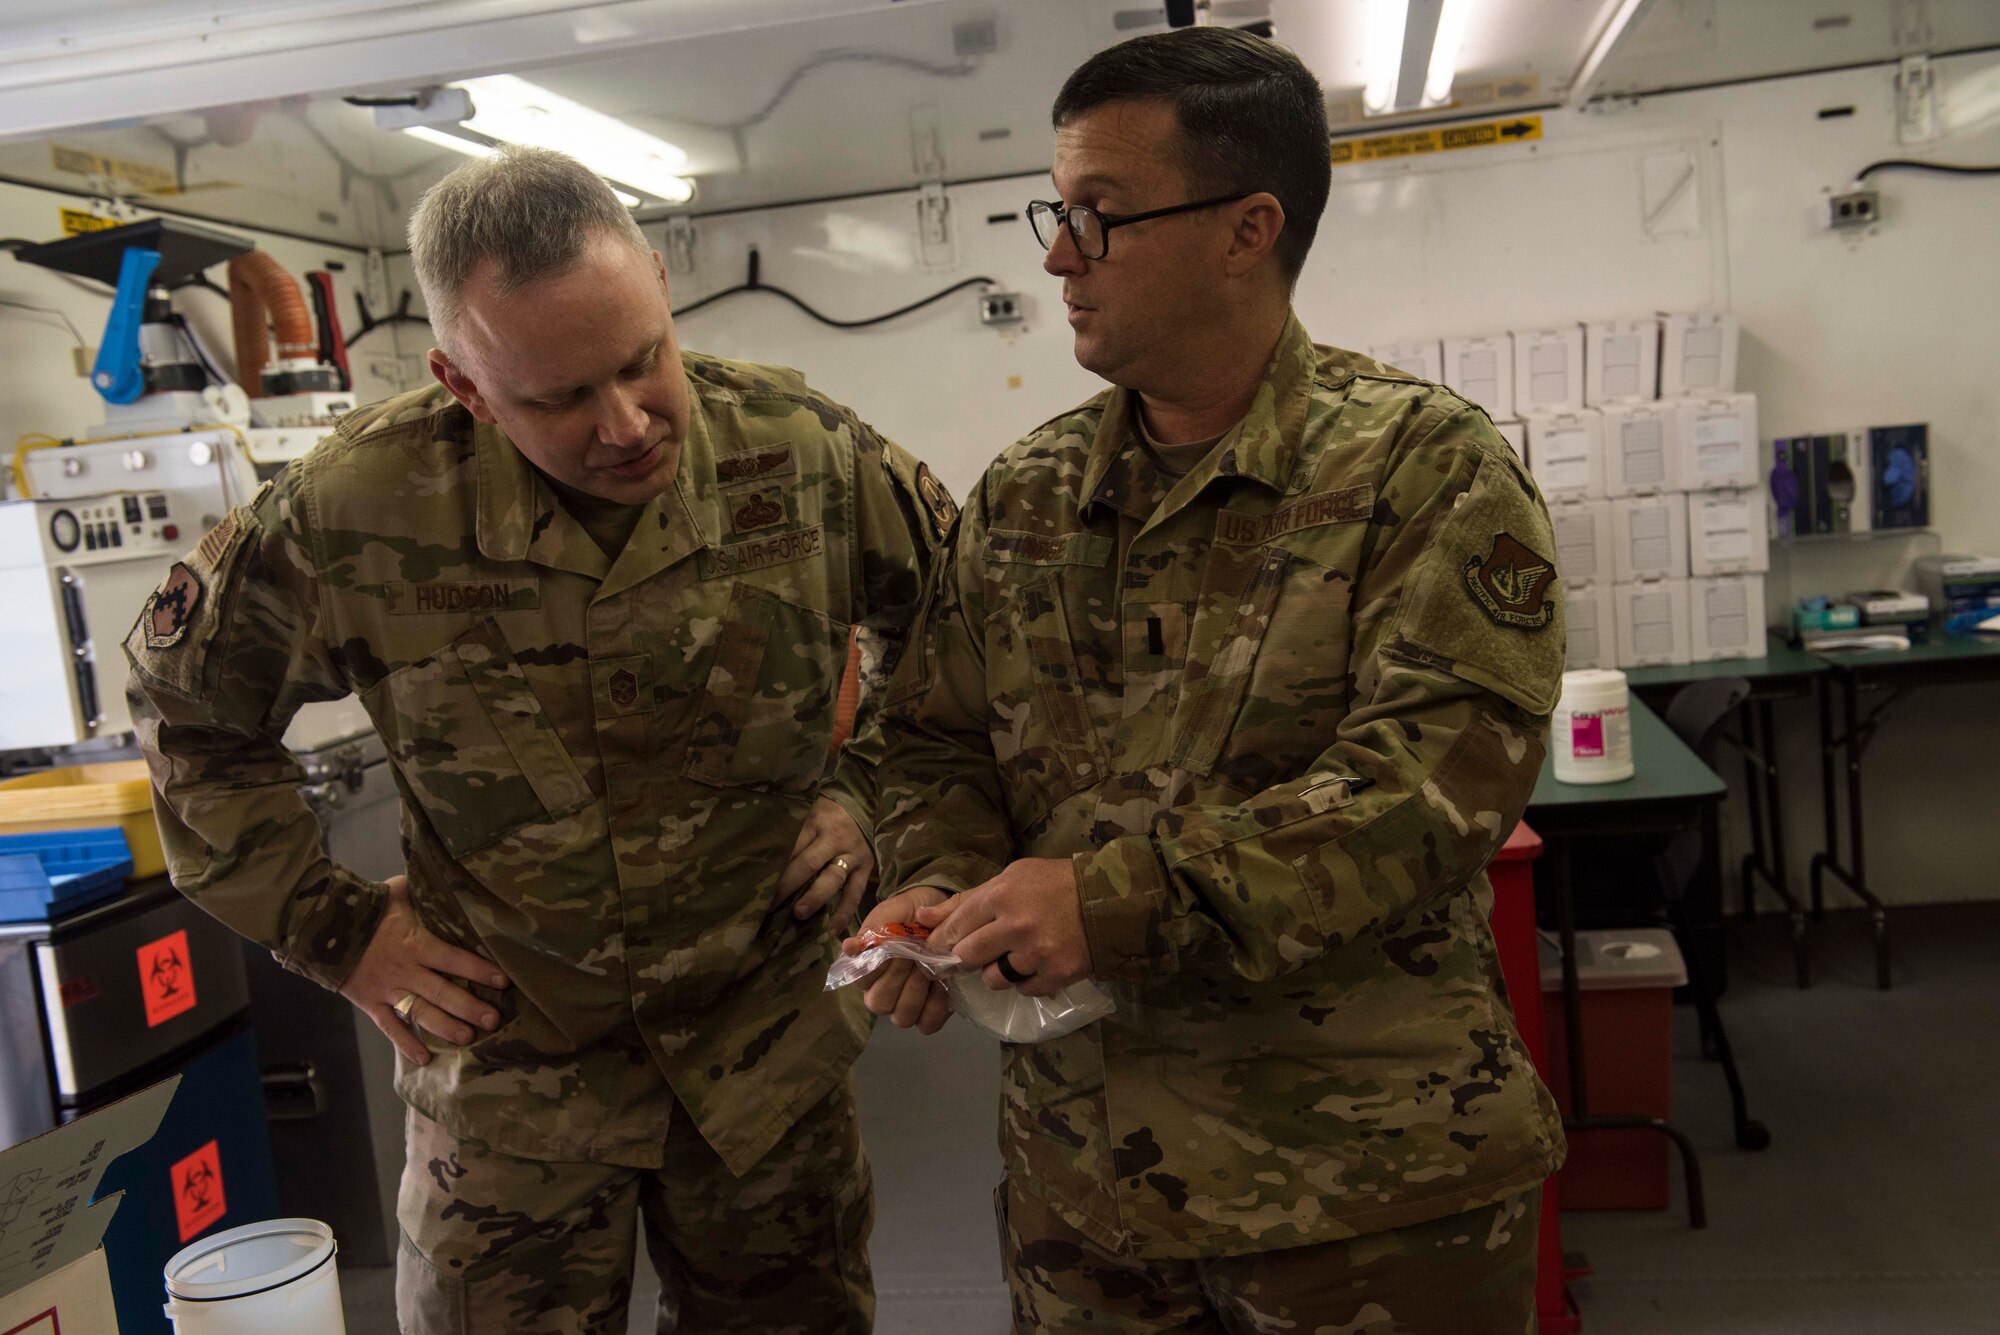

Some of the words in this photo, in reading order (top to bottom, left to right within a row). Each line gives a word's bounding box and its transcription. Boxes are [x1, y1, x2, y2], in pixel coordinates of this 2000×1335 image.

[1294, 491, 1361, 527] FORCE
[738, 544, 765, 567] AIR
[767, 529, 820, 560] FORCE
[416, 583, 510, 611] HUDSON
[1467, 576, 1494, 608] PACIFIC
[1509, 613, 1543, 625] FORCES
